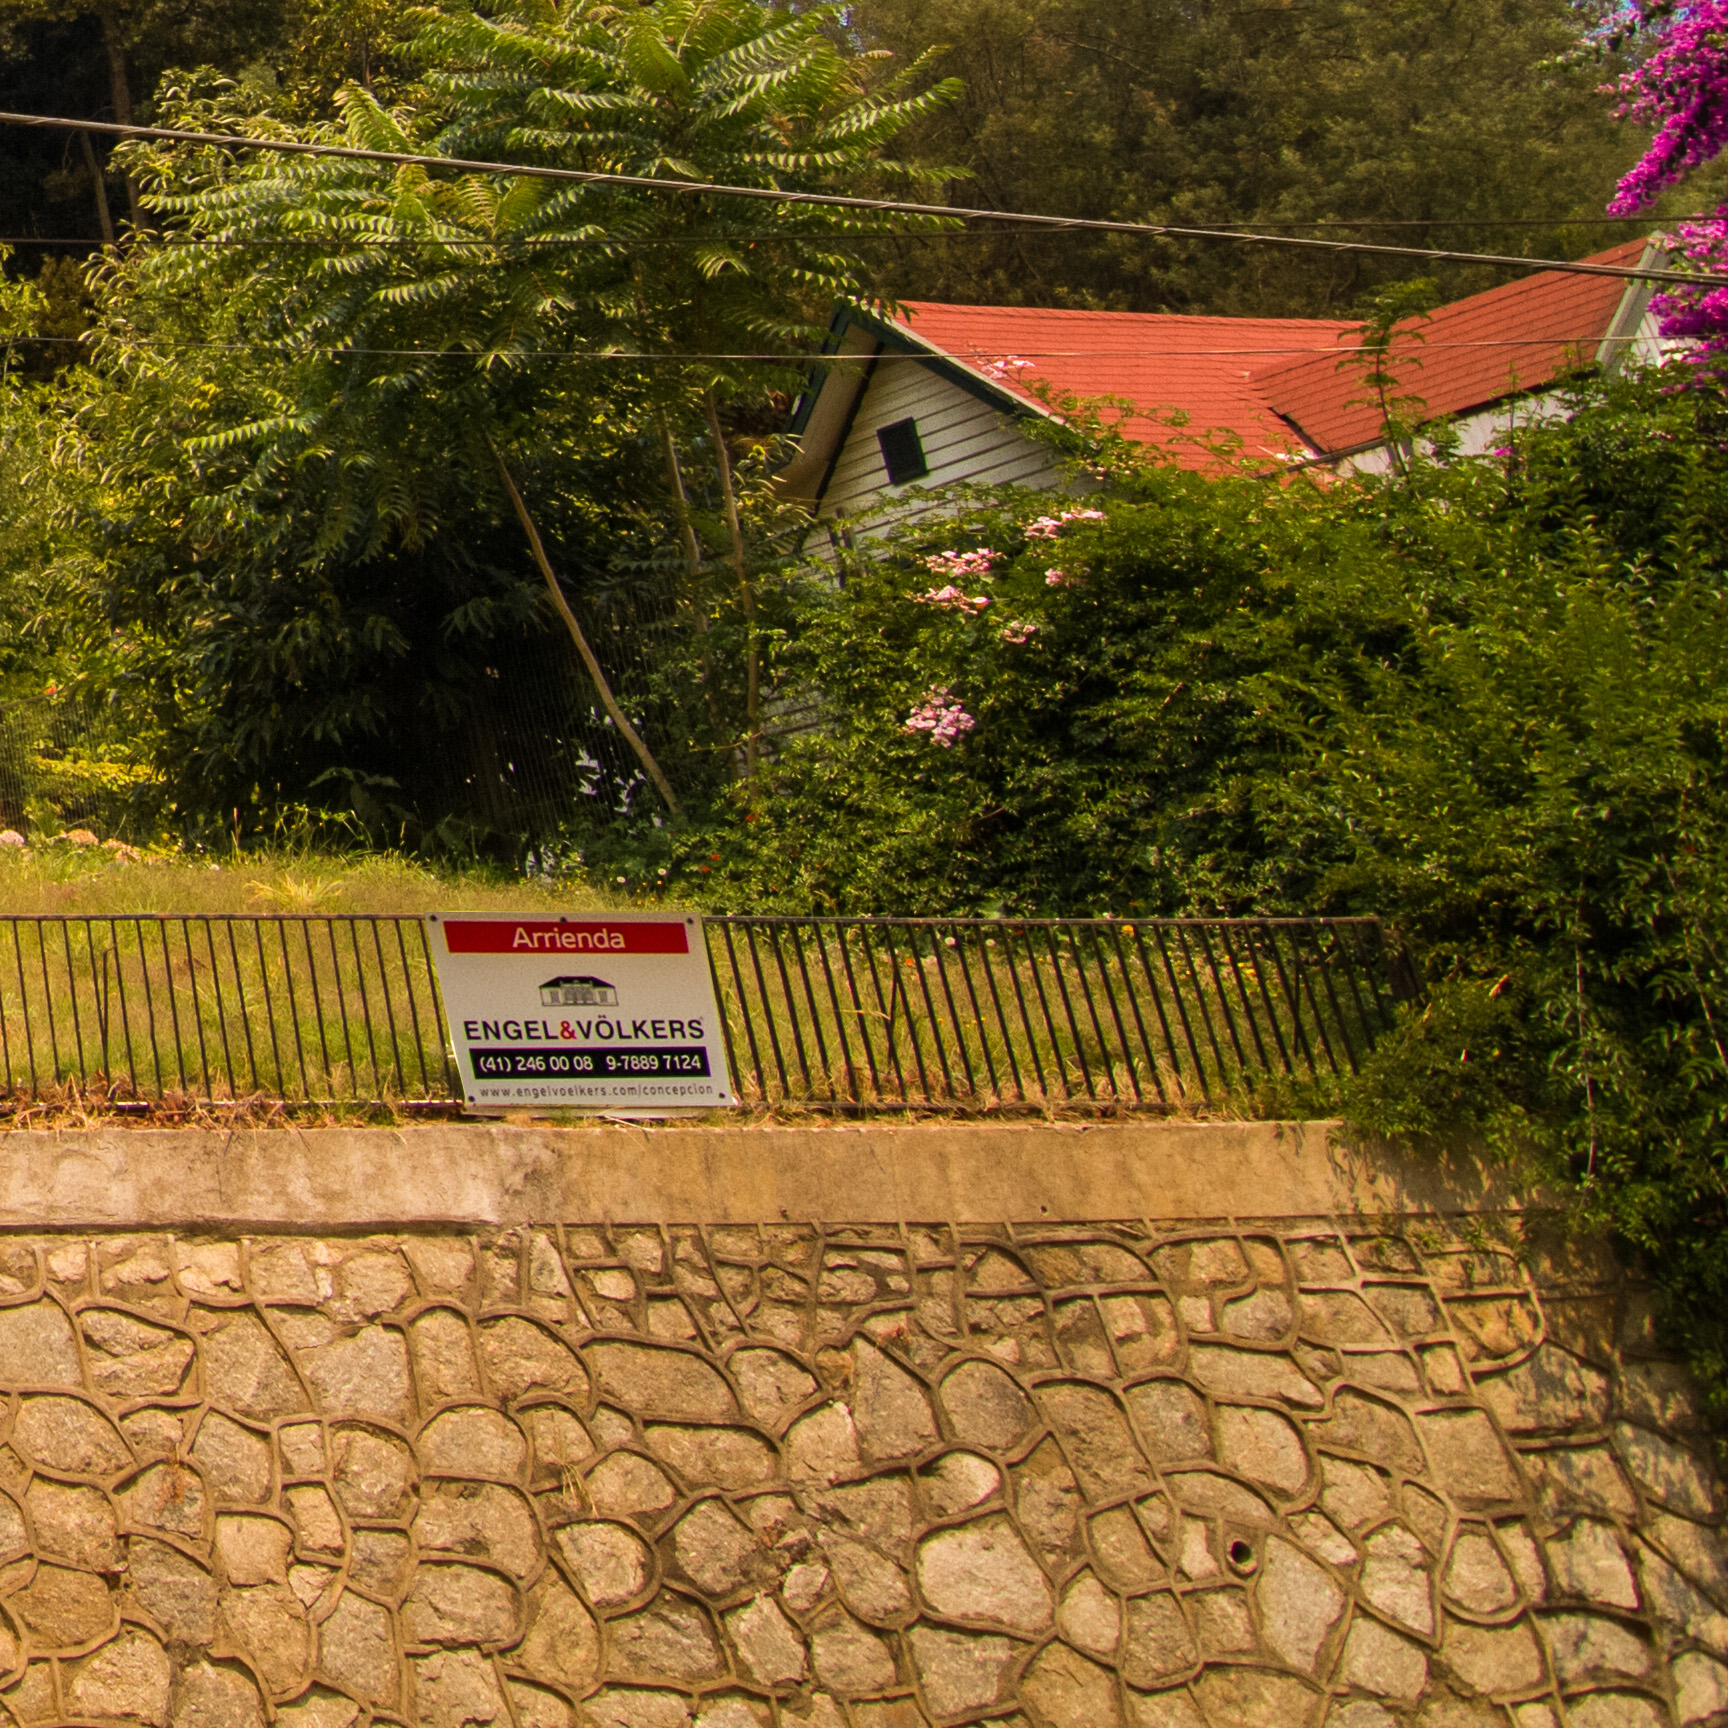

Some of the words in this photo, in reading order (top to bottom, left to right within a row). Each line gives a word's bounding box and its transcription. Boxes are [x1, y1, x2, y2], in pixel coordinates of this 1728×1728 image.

[512, 927, 625, 949] Arrienda
[463, 1014, 705, 1040] ENGEL&VÖLKERS
[479, 1056, 511, 1073] (41)
[516, 1056, 546, 1071] 246
[549, 1055, 570, 1071] 00
[573, 1055, 594, 1071] 08
[606, 1055, 659, 1070] 9-7889
[662, 1054, 702, 1069] 7124
[479, 1083, 713, 1099] www.engelvoelkers.com/concepcion
